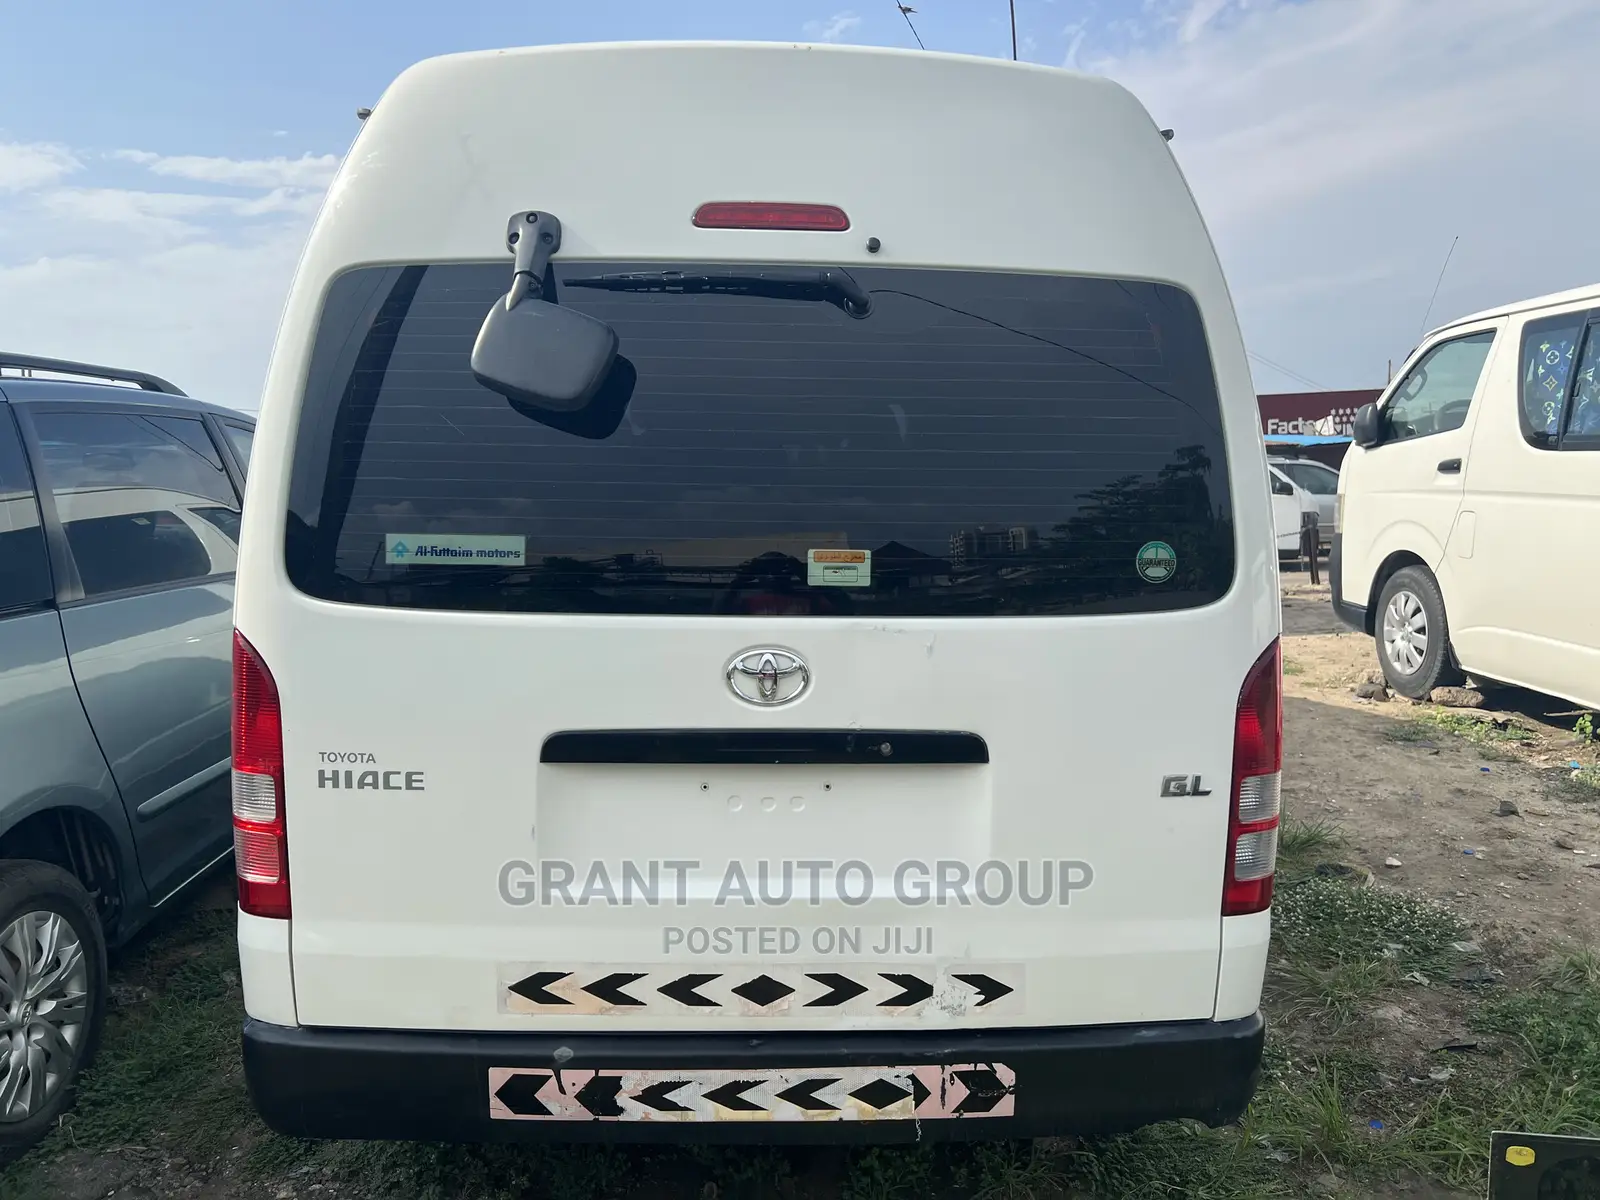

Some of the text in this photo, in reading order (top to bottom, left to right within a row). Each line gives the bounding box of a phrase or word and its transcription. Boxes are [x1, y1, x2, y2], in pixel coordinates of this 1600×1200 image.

[415, 545, 521, 559] Al-Futtaim motors
[1138, 558, 1176, 568] GUARANTEED
[318, 751, 377, 764] TOYOTA
[317, 769, 425, 791] HIACE
[1160, 774, 1213, 798] GL
